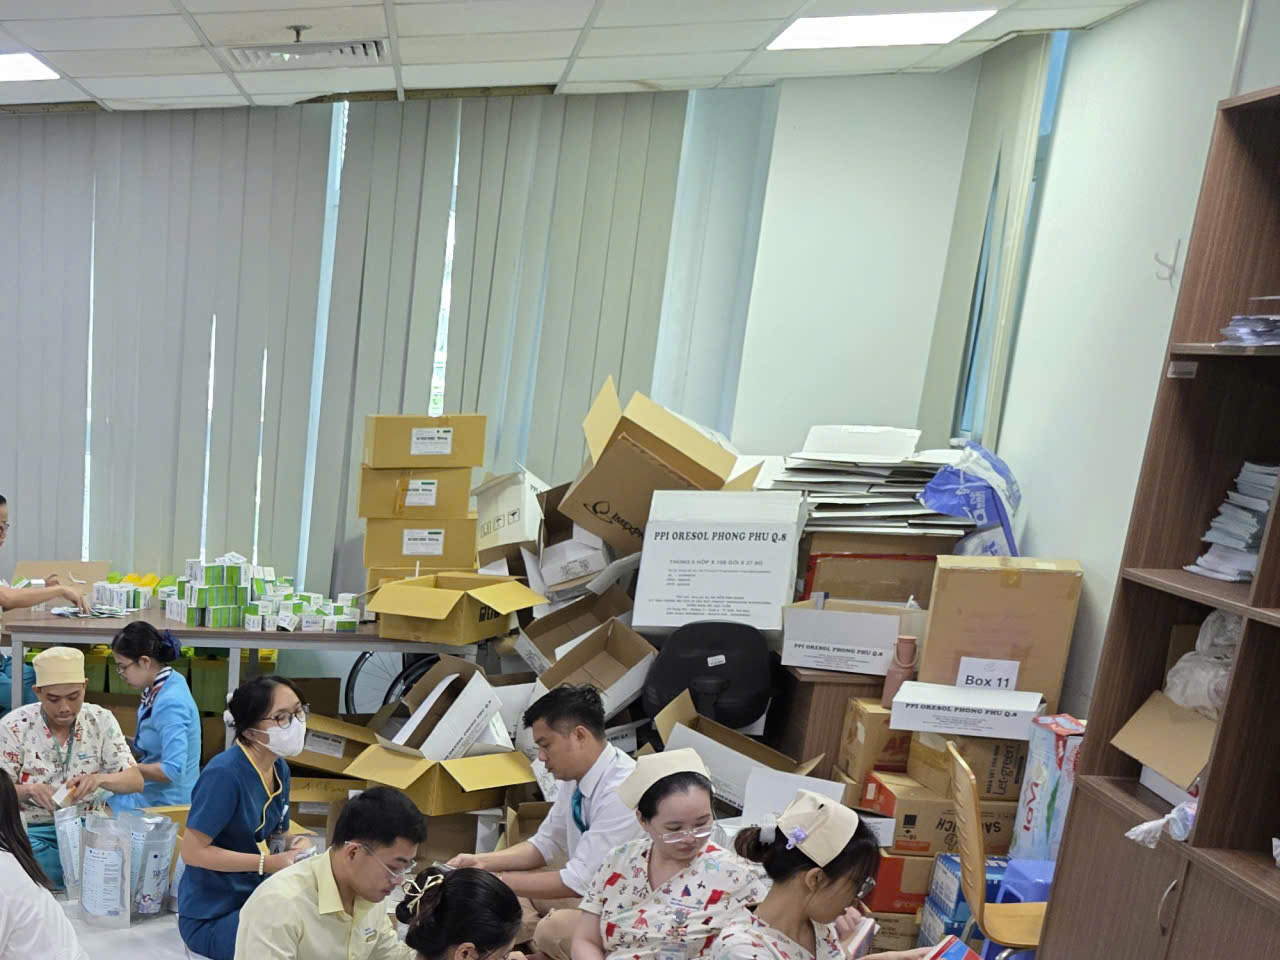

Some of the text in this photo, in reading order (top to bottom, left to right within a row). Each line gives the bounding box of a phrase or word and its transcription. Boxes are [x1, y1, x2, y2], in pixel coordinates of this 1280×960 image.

[654, 531, 787, 543] PPI ORESOL PHONG PHU Q.8
[965, 674, 1009, 688] Box 11
